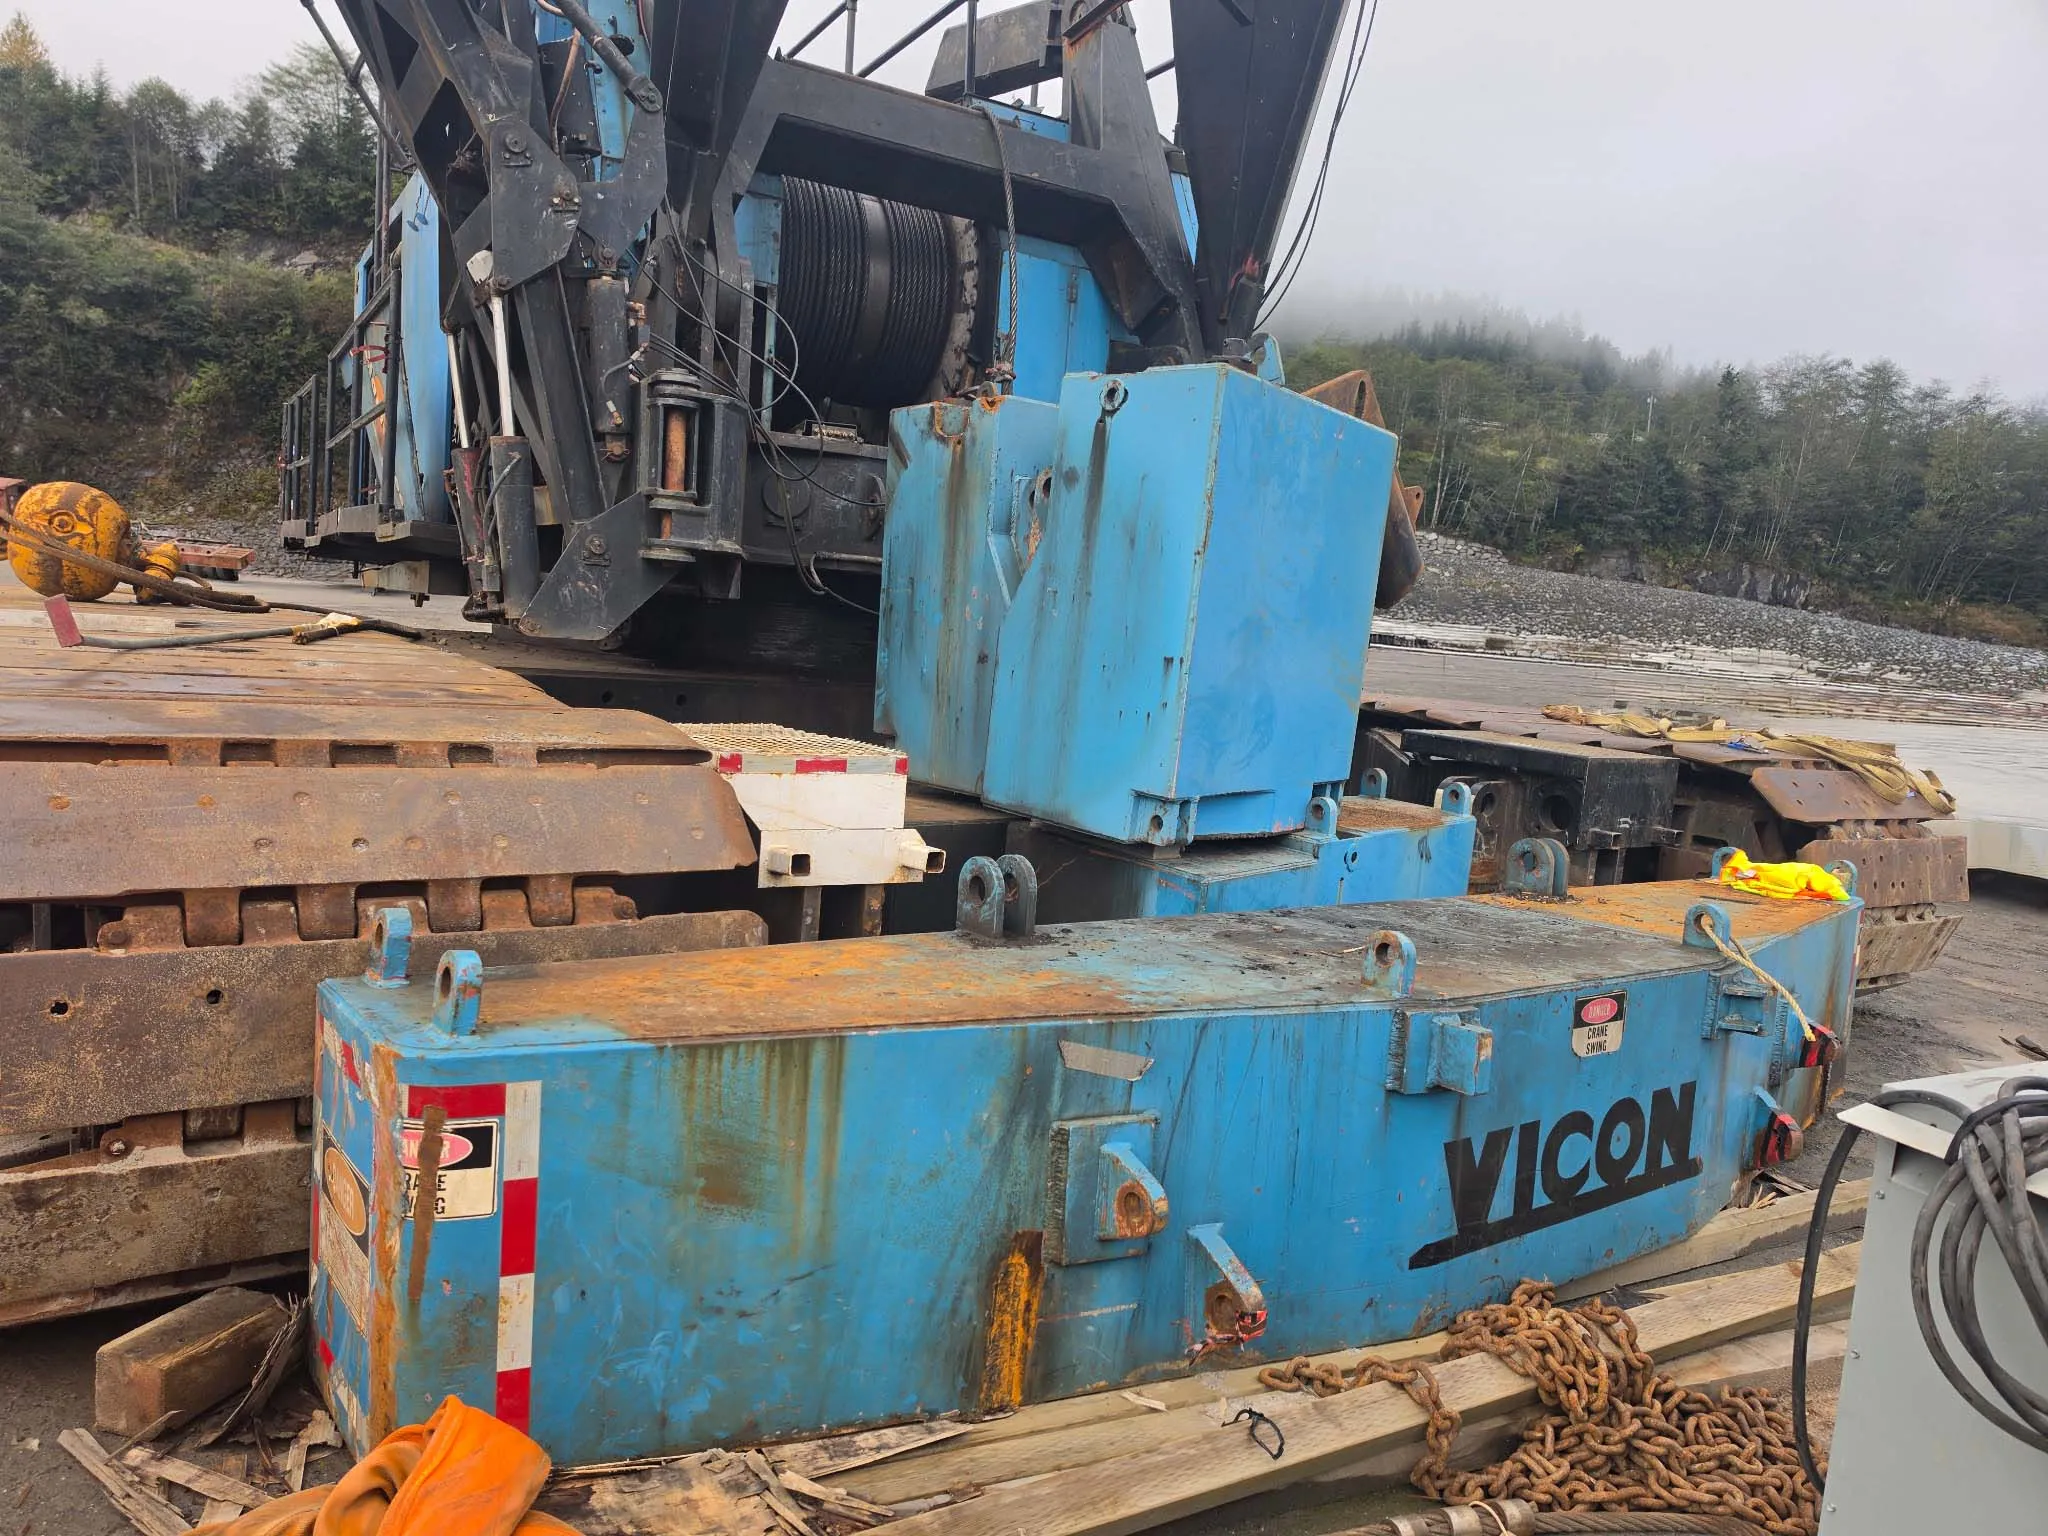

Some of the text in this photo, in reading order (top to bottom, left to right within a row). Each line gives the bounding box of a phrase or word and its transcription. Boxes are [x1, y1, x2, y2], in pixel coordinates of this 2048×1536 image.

[1587, 1024, 1609, 1040] CRANE
[1585, 1039, 1608, 1055] SWING
[401, 1140, 450, 1160] ANR
[1443, 1080, 1697, 1240] VICON
